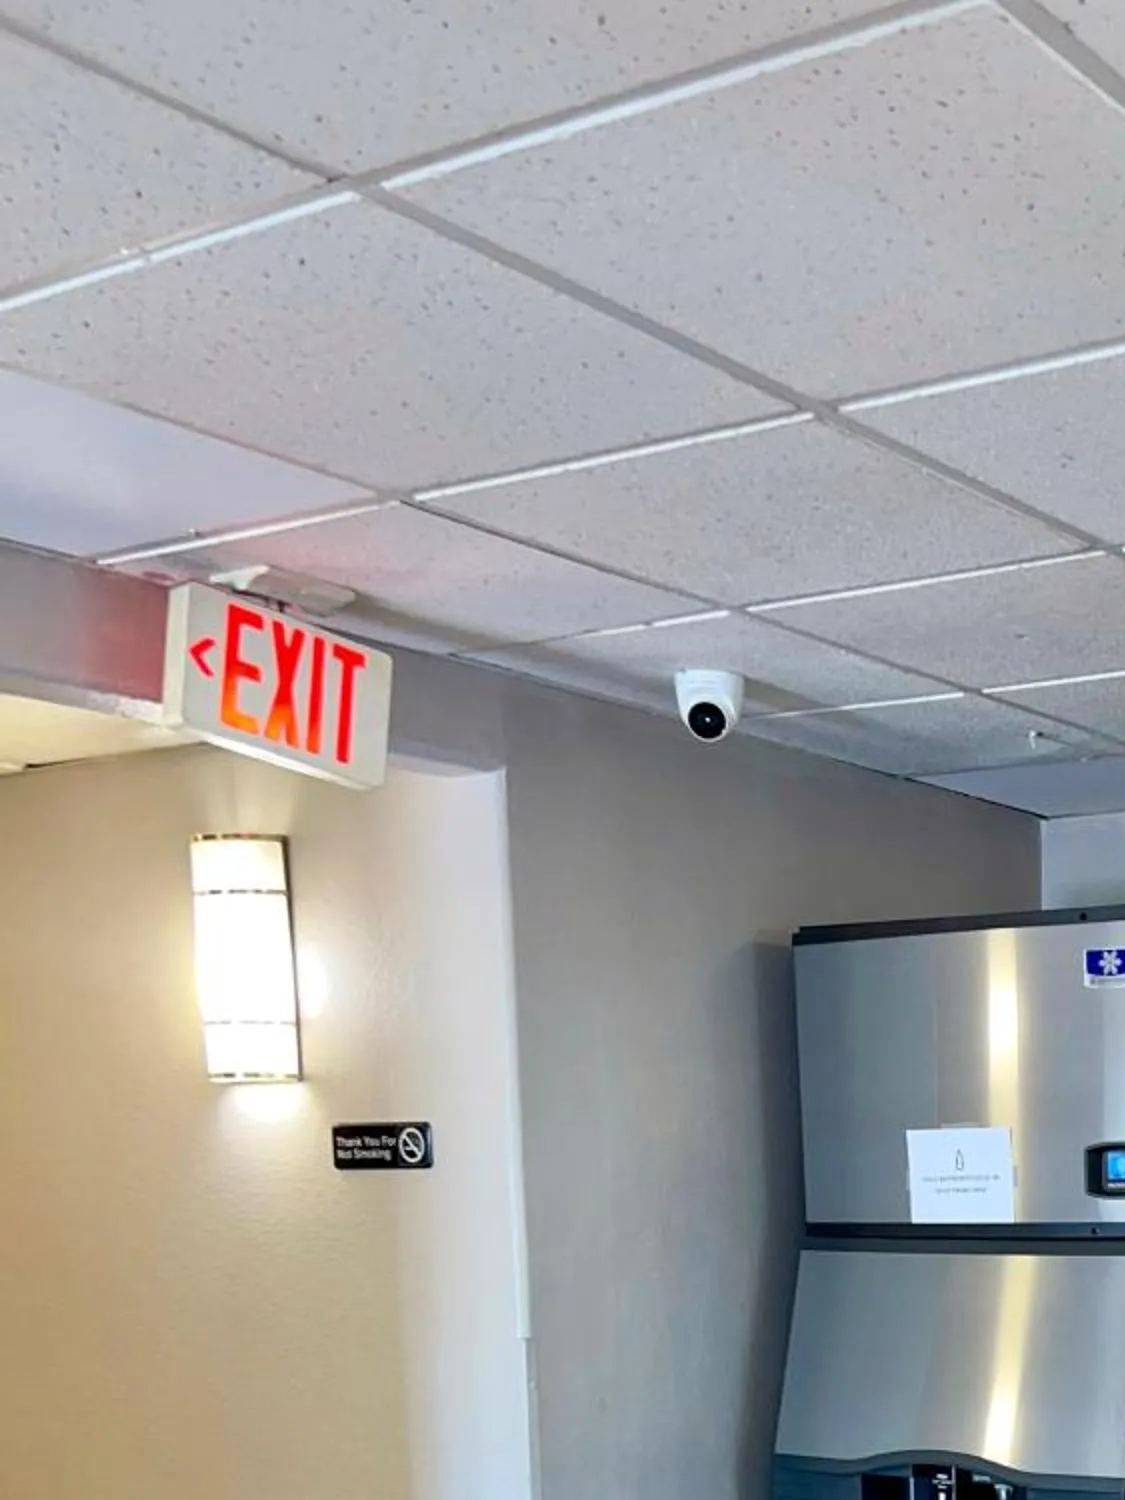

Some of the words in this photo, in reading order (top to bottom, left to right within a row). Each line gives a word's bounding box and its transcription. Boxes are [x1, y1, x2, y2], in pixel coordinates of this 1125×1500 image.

[220, 603, 366, 765] EXIT
[336, 1135, 362, 1147] Thank
[362, 1135, 381, 1147] You
[381, 1135, 397, 1147] For
[336, 1149, 353, 1159] Not
[353, 1148, 392, 1161] Smoking
